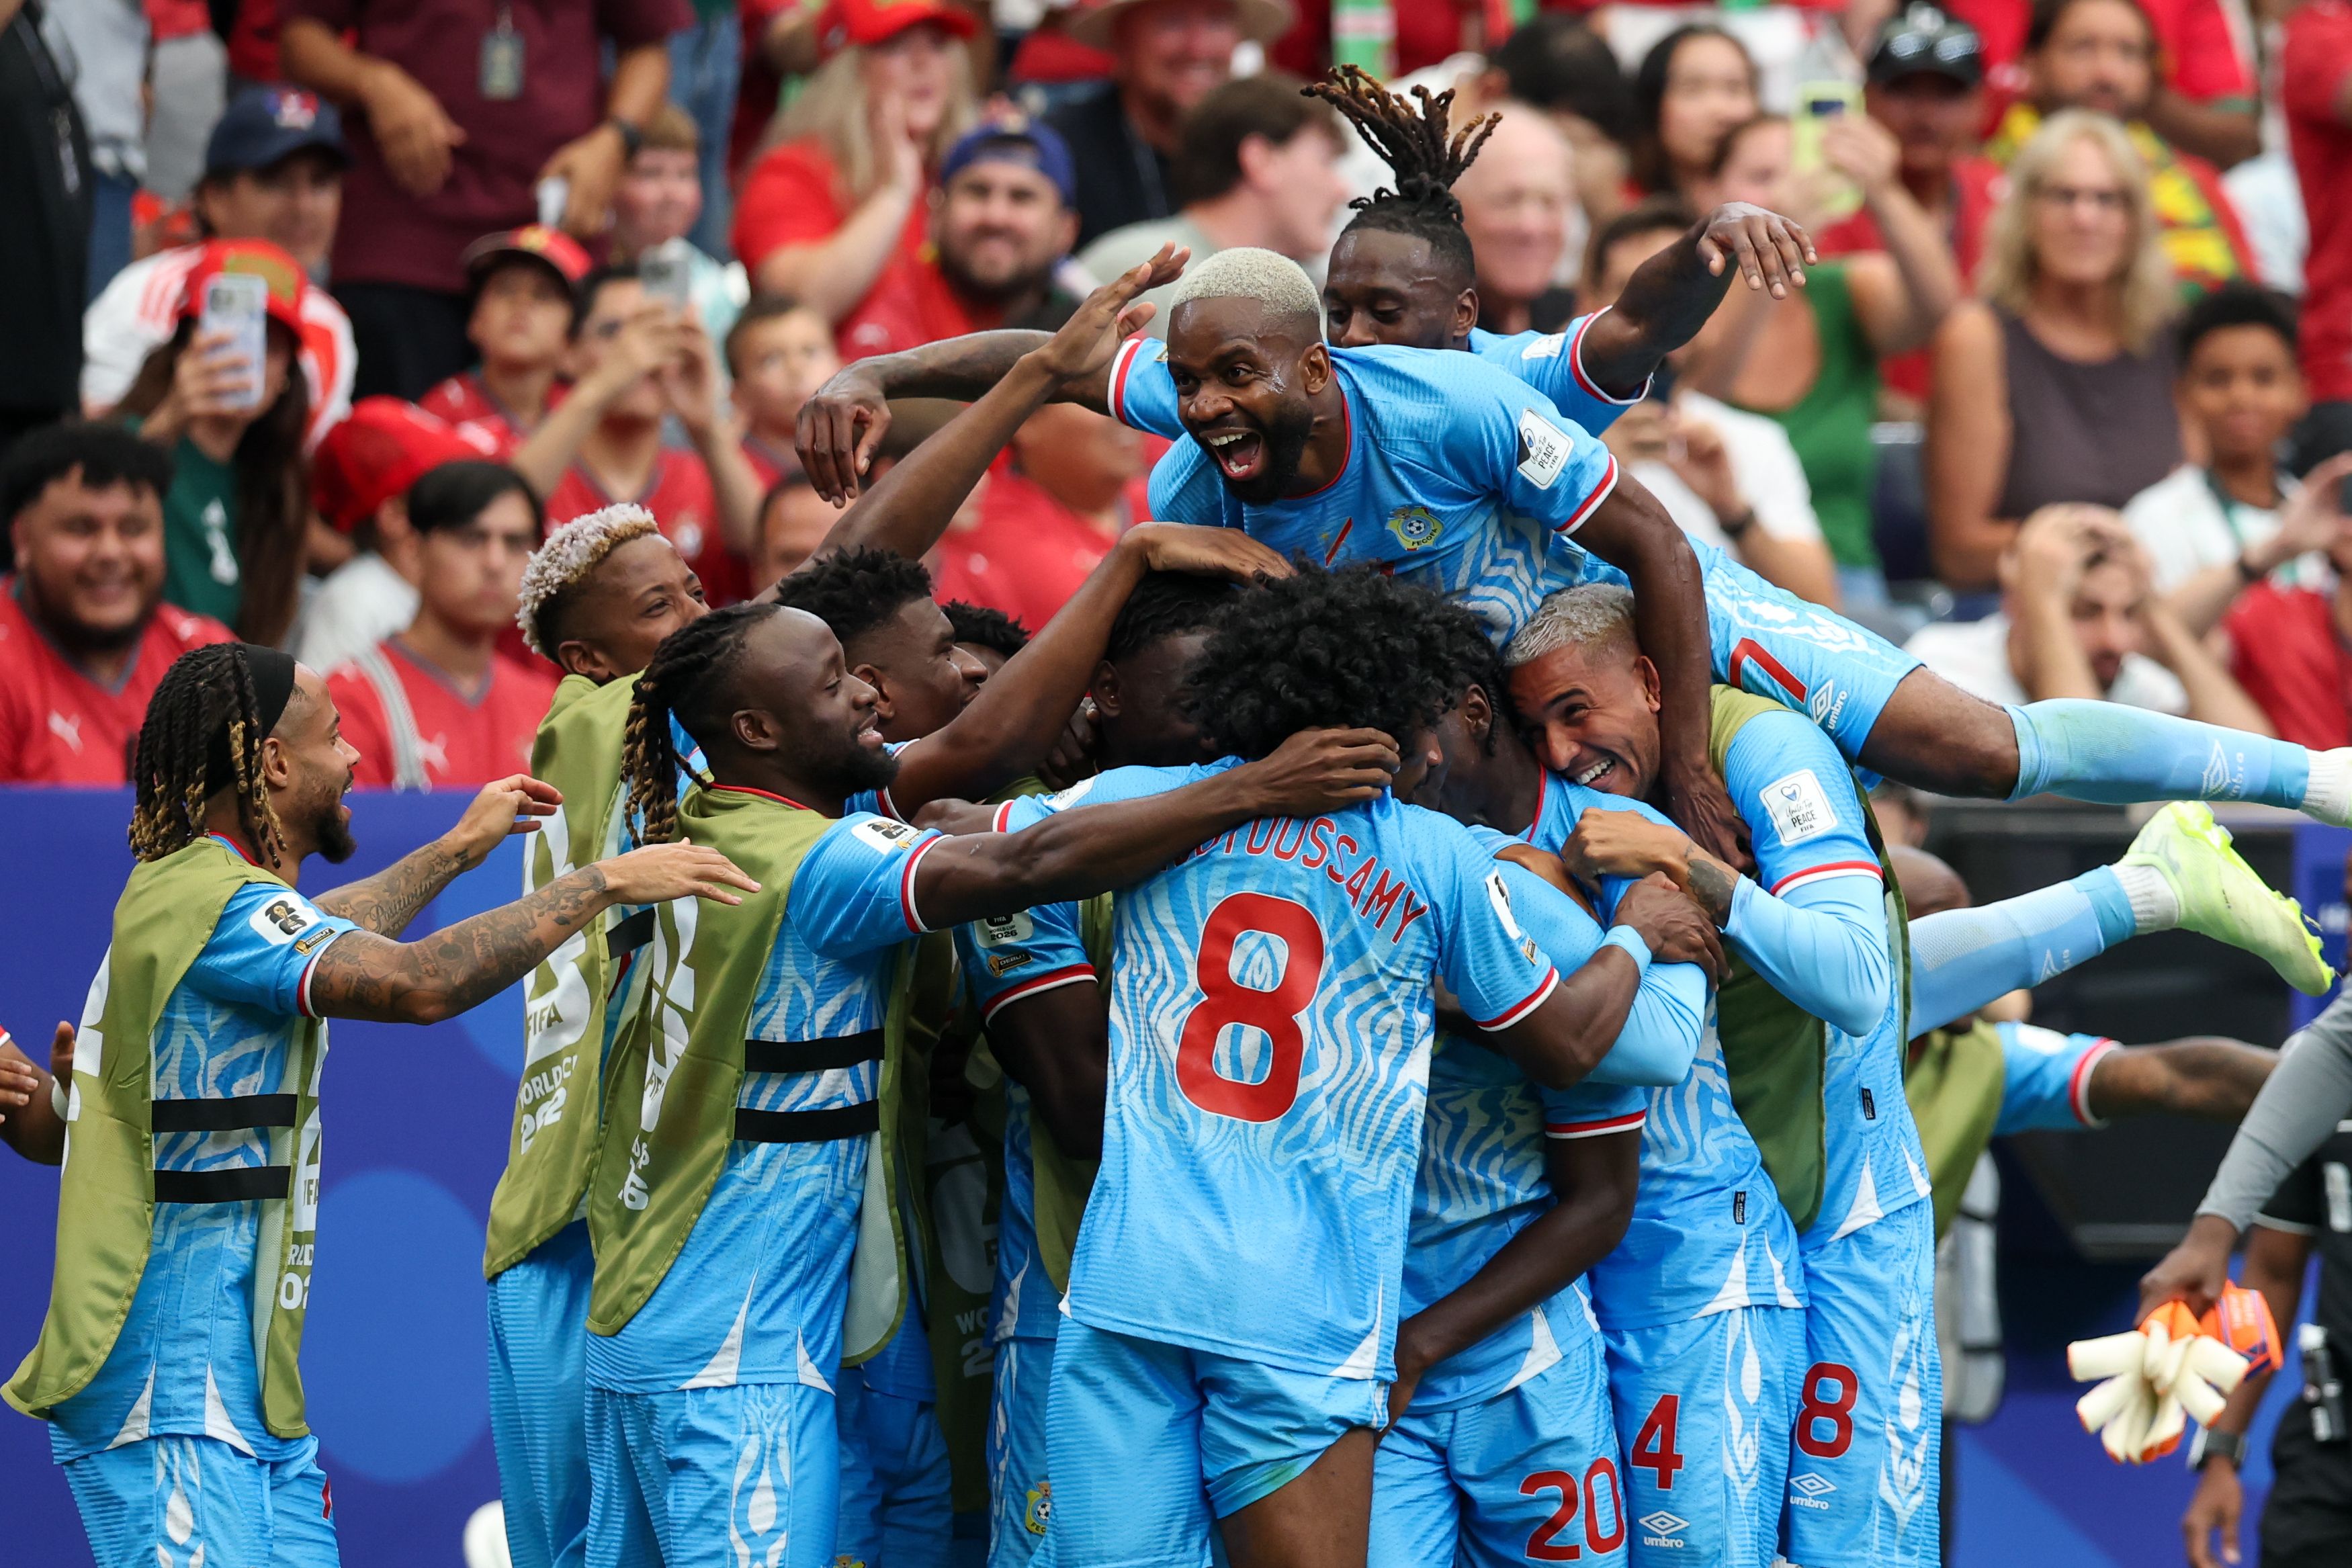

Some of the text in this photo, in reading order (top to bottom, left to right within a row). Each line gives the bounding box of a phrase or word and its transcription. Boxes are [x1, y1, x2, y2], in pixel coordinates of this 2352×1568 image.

[1538, 442, 1556, 469] PEACE
[1549, 455, 1559, 469] FIFA
[1411, 528, 1438, 546] FECOFA
[1827, 690, 1847, 730] umbro
[1791, 809, 1817, 828] PEACE
[1800, 824, 1815, 832] FIFA
[306, 928, 331, 946] DEBUT
[990, 929, 1018, 941] 2026
[999, 953, 1026, 966] DEBUT
[1175, 890, 1325, 1123] 8
[1795, 1360, 1860, 1459] 8
[1630, 1393, 1684, 1491] 4
[1518, 1456, 1626, 1561] 20
[1789, 1495, 1829, 1511] umbro
[1643, 1536, 1684, 1549] umbro
